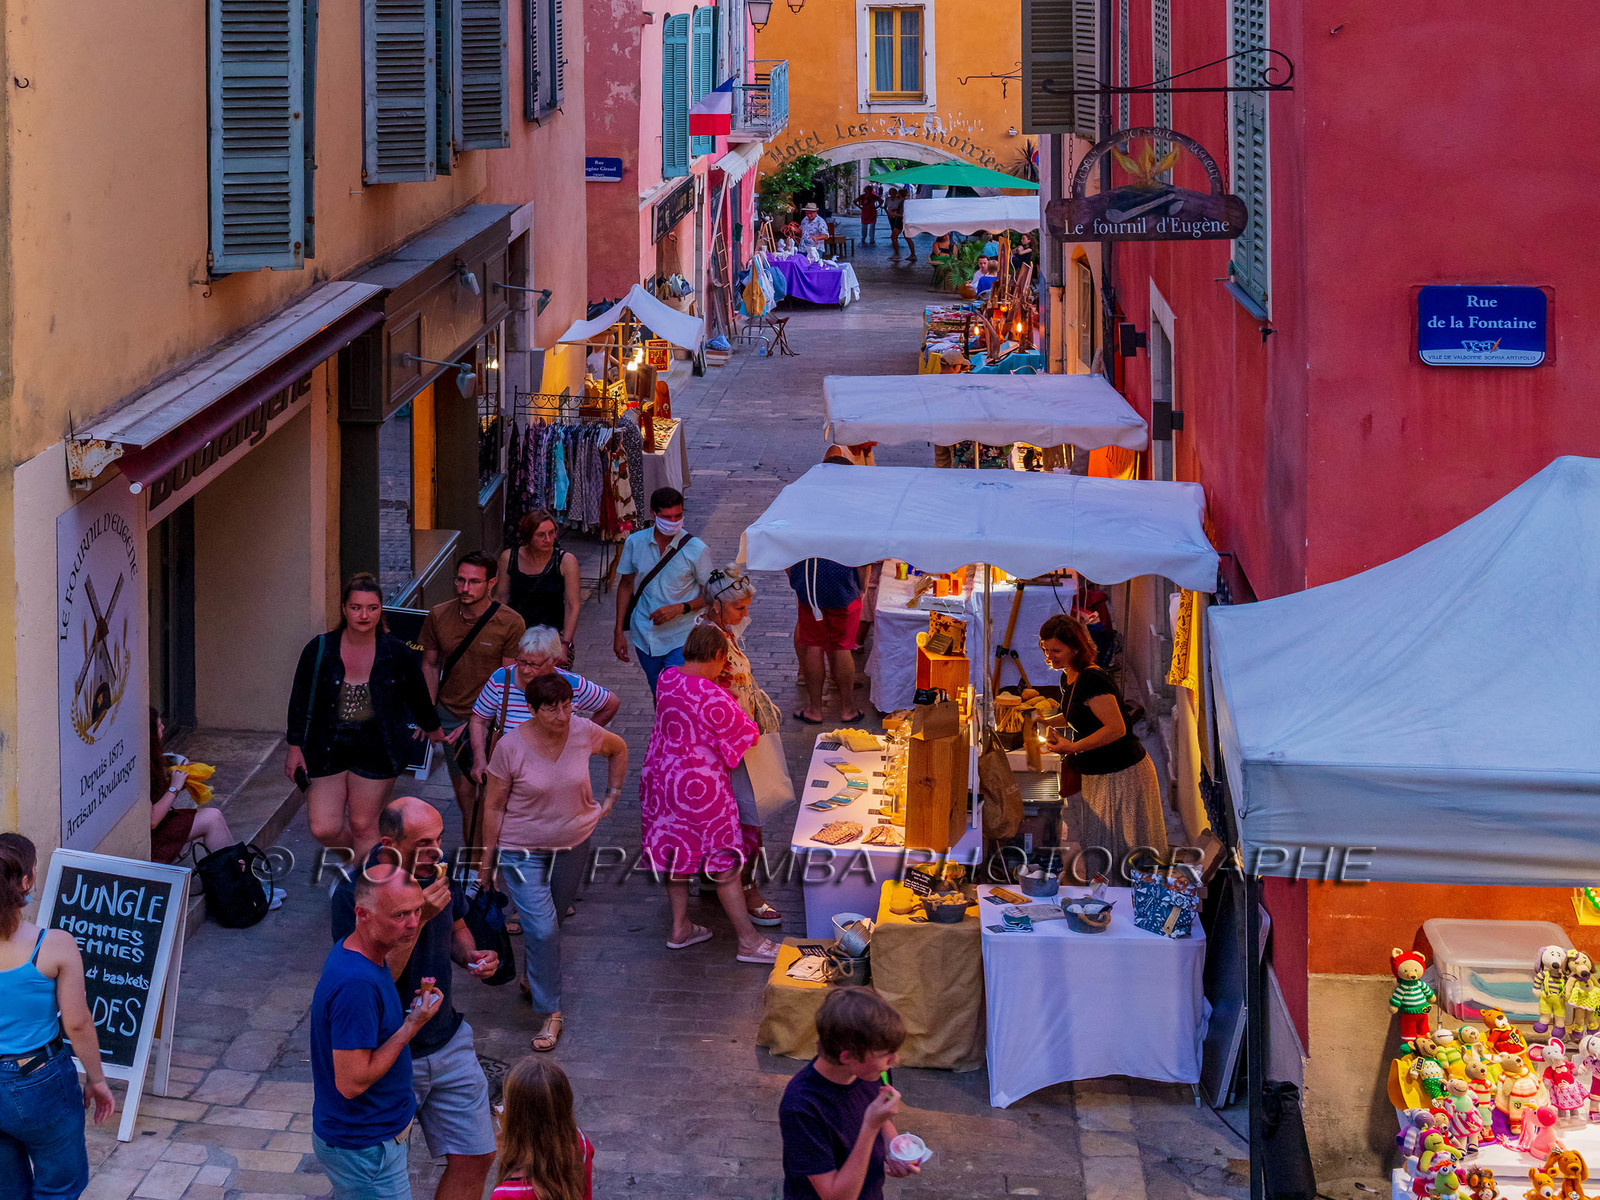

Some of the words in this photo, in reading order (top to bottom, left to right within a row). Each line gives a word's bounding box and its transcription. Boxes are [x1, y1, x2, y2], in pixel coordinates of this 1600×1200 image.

[1063, 219, 1084, 235] Le
[1093, 217, 1147, 234] fournil
[1156, 217, 1230, 238] d'Eugène
[1466, 295, 1498, 308] Rue
[1427, 315, 1446, 328] de
[1449, 315, 1464, 328] la
[1468, 315, 1537, 329] Fontaine
[80, 758, 108, 798] Depuis
[109, 739, 125, 767] 1873
[66, 798, 97, 841] Artisan
[98, 755, 137, 806] Boulanger
[61, 874, 164, 923] JUNGLE
[59, 915, 144, 946] HOMMES
[75, 937, 145, 963] EMMES
[103, 968, 149, 990] baskets
[92, 996, 141, 1037] DES
